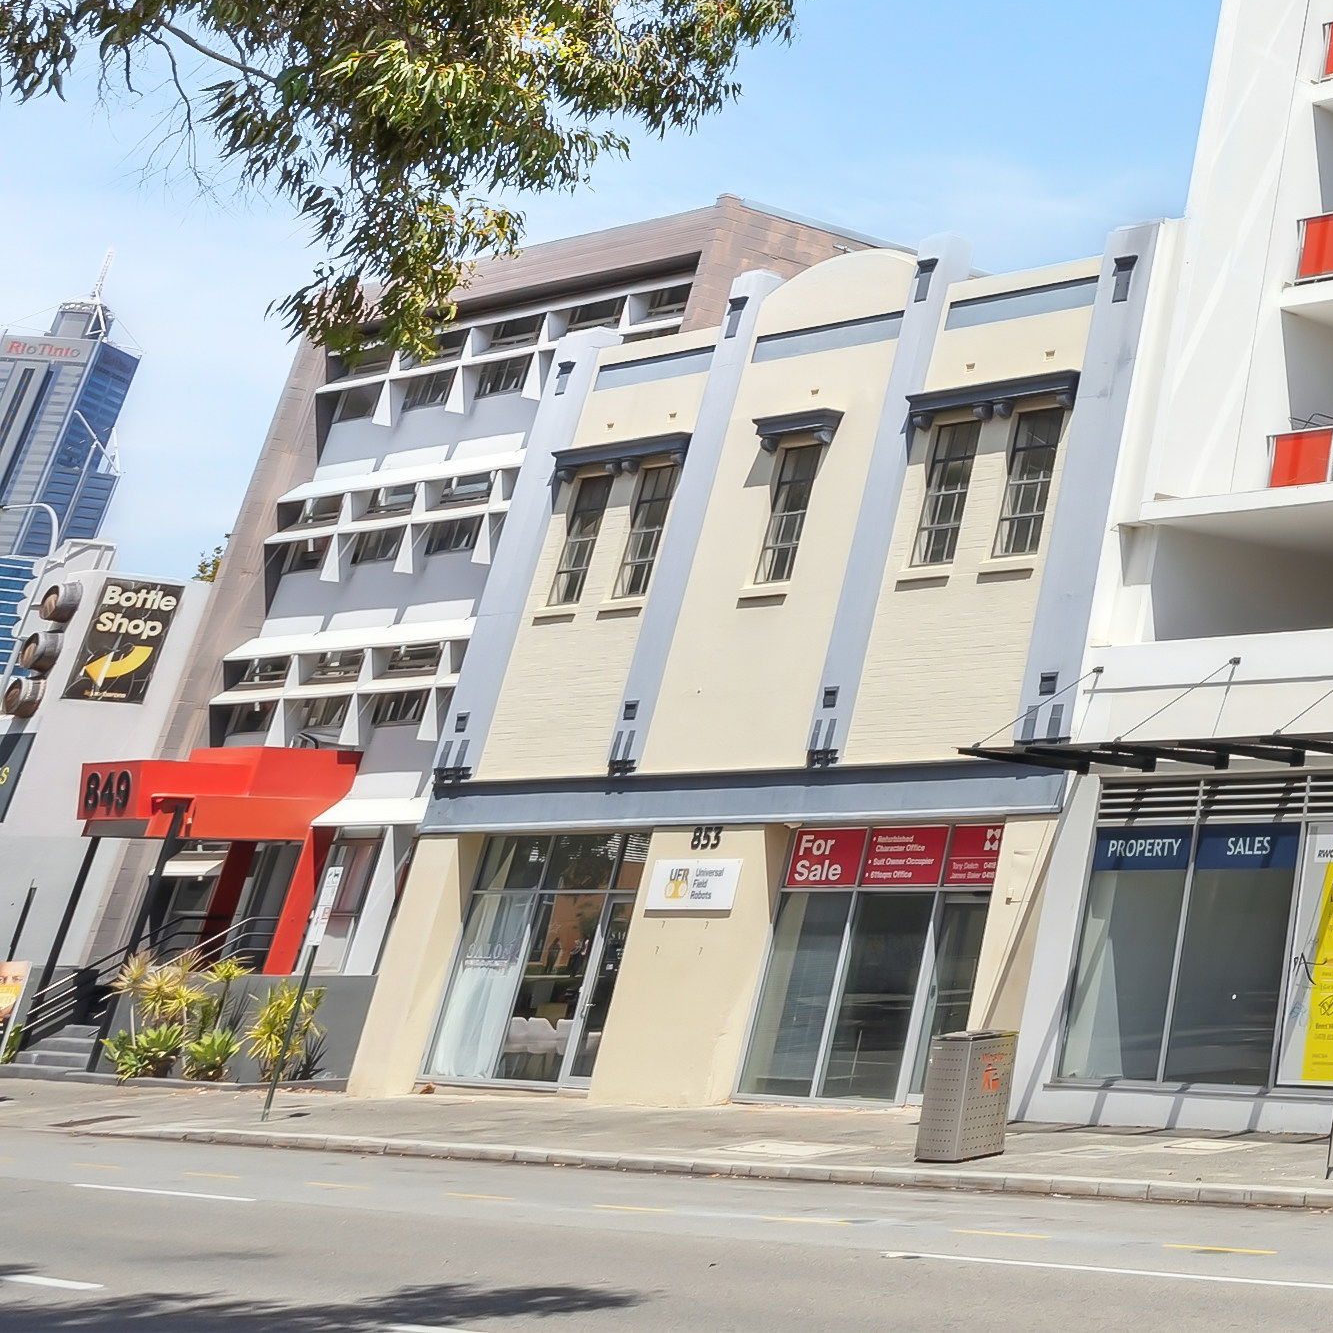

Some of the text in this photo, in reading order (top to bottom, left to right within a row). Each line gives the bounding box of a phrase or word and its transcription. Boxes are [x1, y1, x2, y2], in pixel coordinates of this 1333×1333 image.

[101, 585, 177, 611] Bottle
[96, 611, 162, 640] Shop
[84, 770, 131, 812] 849
[690, 826, 724, 850] 853
[798, 834, 835, 856] For
[905, 844, 926, 852] Office
[1107, 837, 1271, 857] PROPERTY SALES
[905, 857, 935, 866] Occupier
[669, 868, 690, 882] UFR
[695, 867, 725, 877] Universal
[794, 860, 843, 881] Sale
[892, 870, 913, 878] Office
[692, 878, 709, 889] Field
[690, 890, 712, 900] Robots
